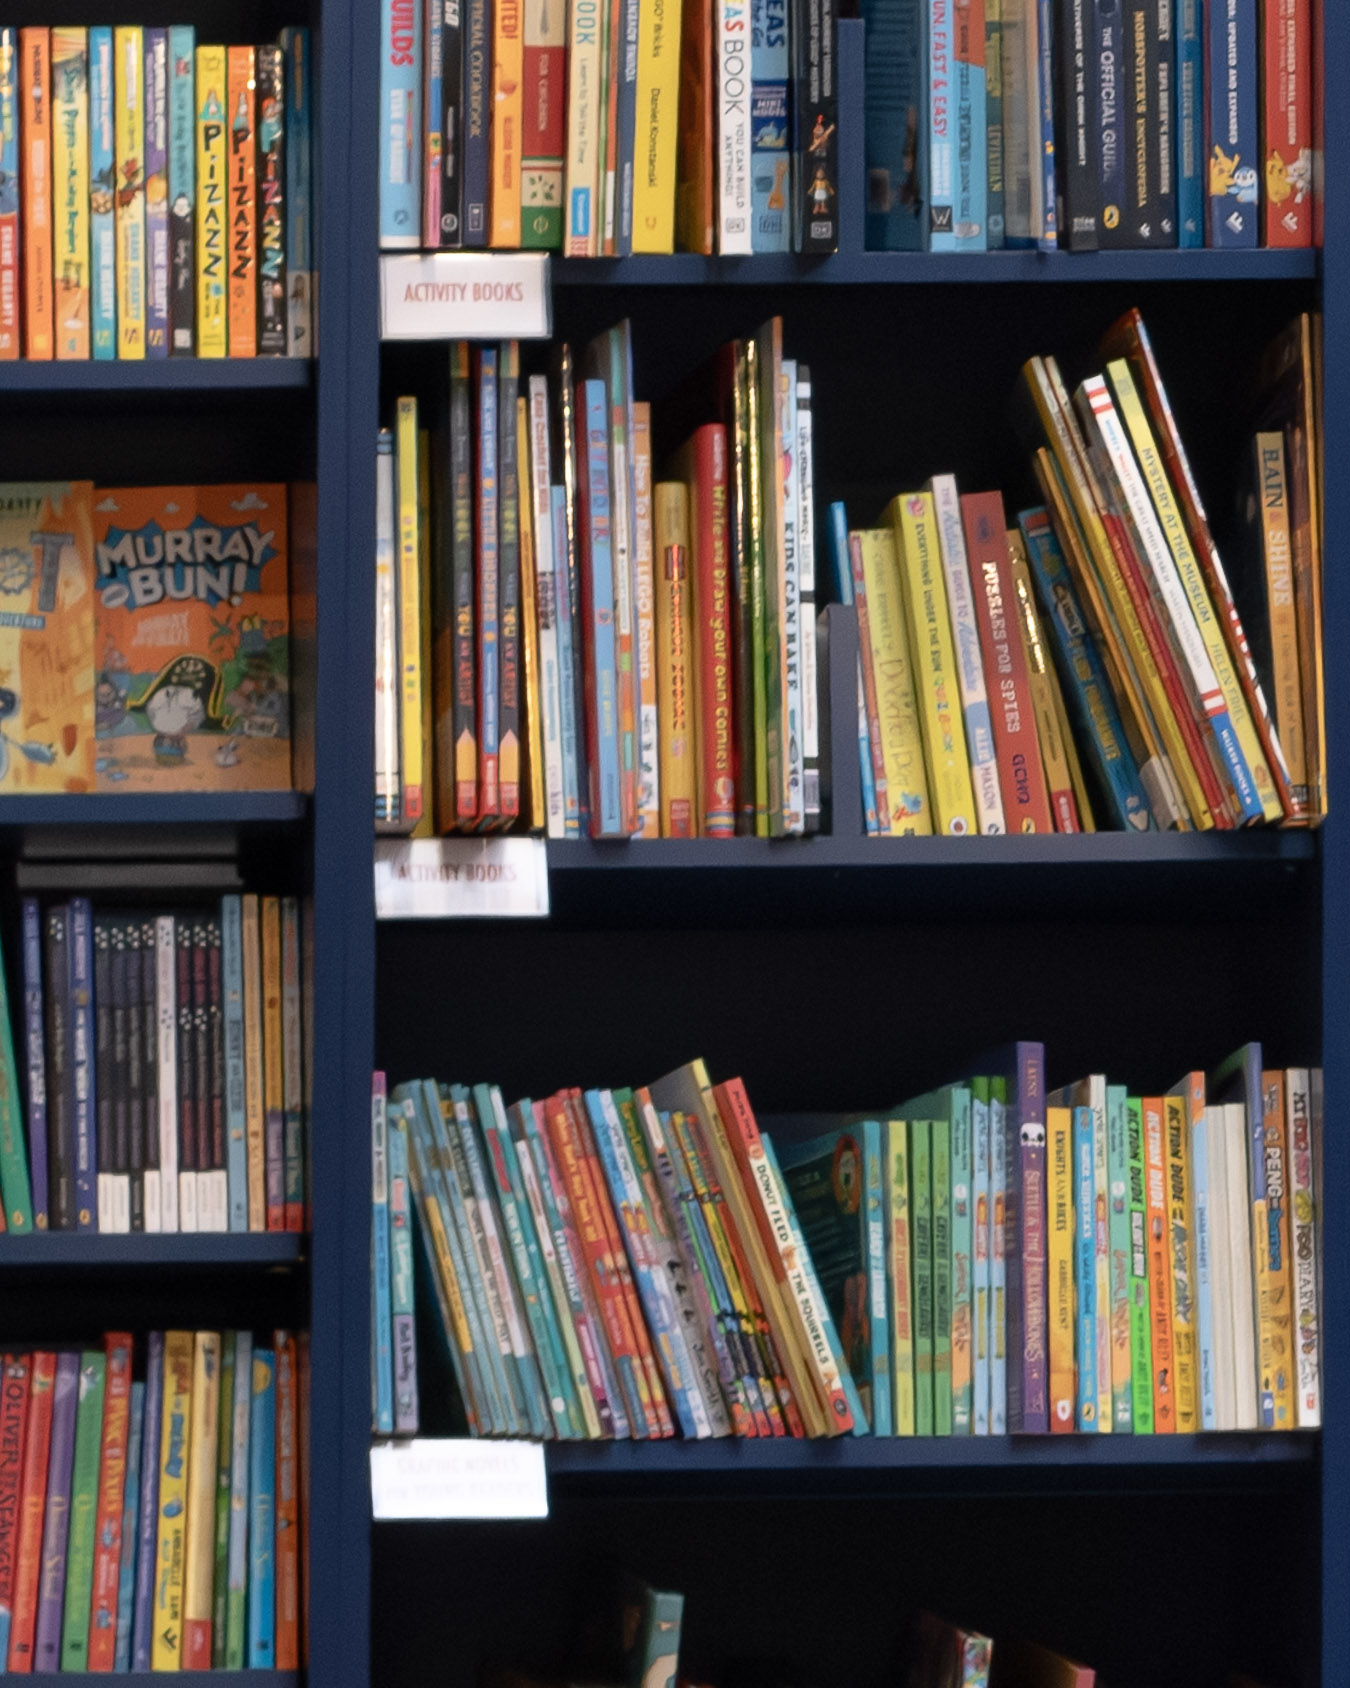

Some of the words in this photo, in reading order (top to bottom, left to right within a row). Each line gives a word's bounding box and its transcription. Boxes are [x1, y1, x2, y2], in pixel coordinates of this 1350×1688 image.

[933, 32, 947, 70] FAST
[1102, 27, 1112, 47] THE
[1228, 22, 1238, 66] UPDATED
[724, 40, 745, 116] BOOK
[934, 80, 948, 91] &
[1100, 51, 1116, 126] OFFICIAL
[1229, 68, 1238, 90] AND
[650, 89, 661, 122] Daniel
[933, 96, 947, 137] EASY
[1228, 92, 1238, 144] EXPANDED
[1287, 105, 1297, 145] EDITION
[735, 124, 744, 147] YOU
[735, 150, 744, 172] CAN
[1136, 118, 1148, 208] ENCYCLOPEDIA
[735, 177, 745, 209] BUILD
[404, 283, 467, 302] ACTIVITY
[472, 282, 524, 301] BOOKS
[1262, 447, 1283, 508] RAIN
[637, 496, 647, 515] To
[713, 485, 726, 536] Write
[95, 527, 276, 577] MURRAY
[784, 521, 797, 576] KIDS
[915, 523, 932, 586] EVERYTHING
[1141, 447, 1173, 510] MYSTERY
[1164, 515, 1180, 532] AT
[1173, 535, 1188, 560] THE
[1183, 563, 1211, 623] MUSEUM
[129, 563, 250, 607] BUN!
[638, 565, 651, 613] LEGO
[713, 568, 727, 612] Draw
[1267, 529, 1290, 608] SHINE
[785, 580, 797, 624] CAN
[981, 561, 1011, 639] PUZZLES
[639, 618, 651, 679] Robots
[709, 619, 726, 659] your
[928, 629, 940, 648] THE
[997, 642, 1014, 675] FOR
[714, 665, 728, 702] own
[786, 632, 799, 691] BAKE
[930, 650, 941, 673] SUN
[1000, 679, 1021, 733] SPIES
[714, 707, 728, 770] Comics
[981, 766, 997, 810] MASON
[1011, 753, 1031, 805] GCHQ
[398, 863, 460, 881] ACTIVITY
[465, 863, 517, 882] BOOKS
[1055, 1130, 1066, 1175] KNIGHTS
[1127, 1107, 1141, 1163] ACTION
[1147, 1111, 1161, 1167] ACTION
[1168, 1105, 1183, 1161] ACTION
[1129, 1165, 1143, 1205] DUDE
[1149, 1169, 1163, 1209] DUDE
[1172, 1164, 1184, 1203] DUDE
[1055, 1201, 1067, 1232] BIKES
[756, 1165, 776, 1206] DONUT
[772, 1210, 789, 1242] FEED
[792, 1273, 806, 1295] THE
[803, 1298, 829, 1365] SQUIRRELS
[1299, 1261, 1314, 1310] DIARY
[1024, 1264, 1044, 1362] HOLLOWBONES
[2, 1382, 23, 1466] OLIVER
